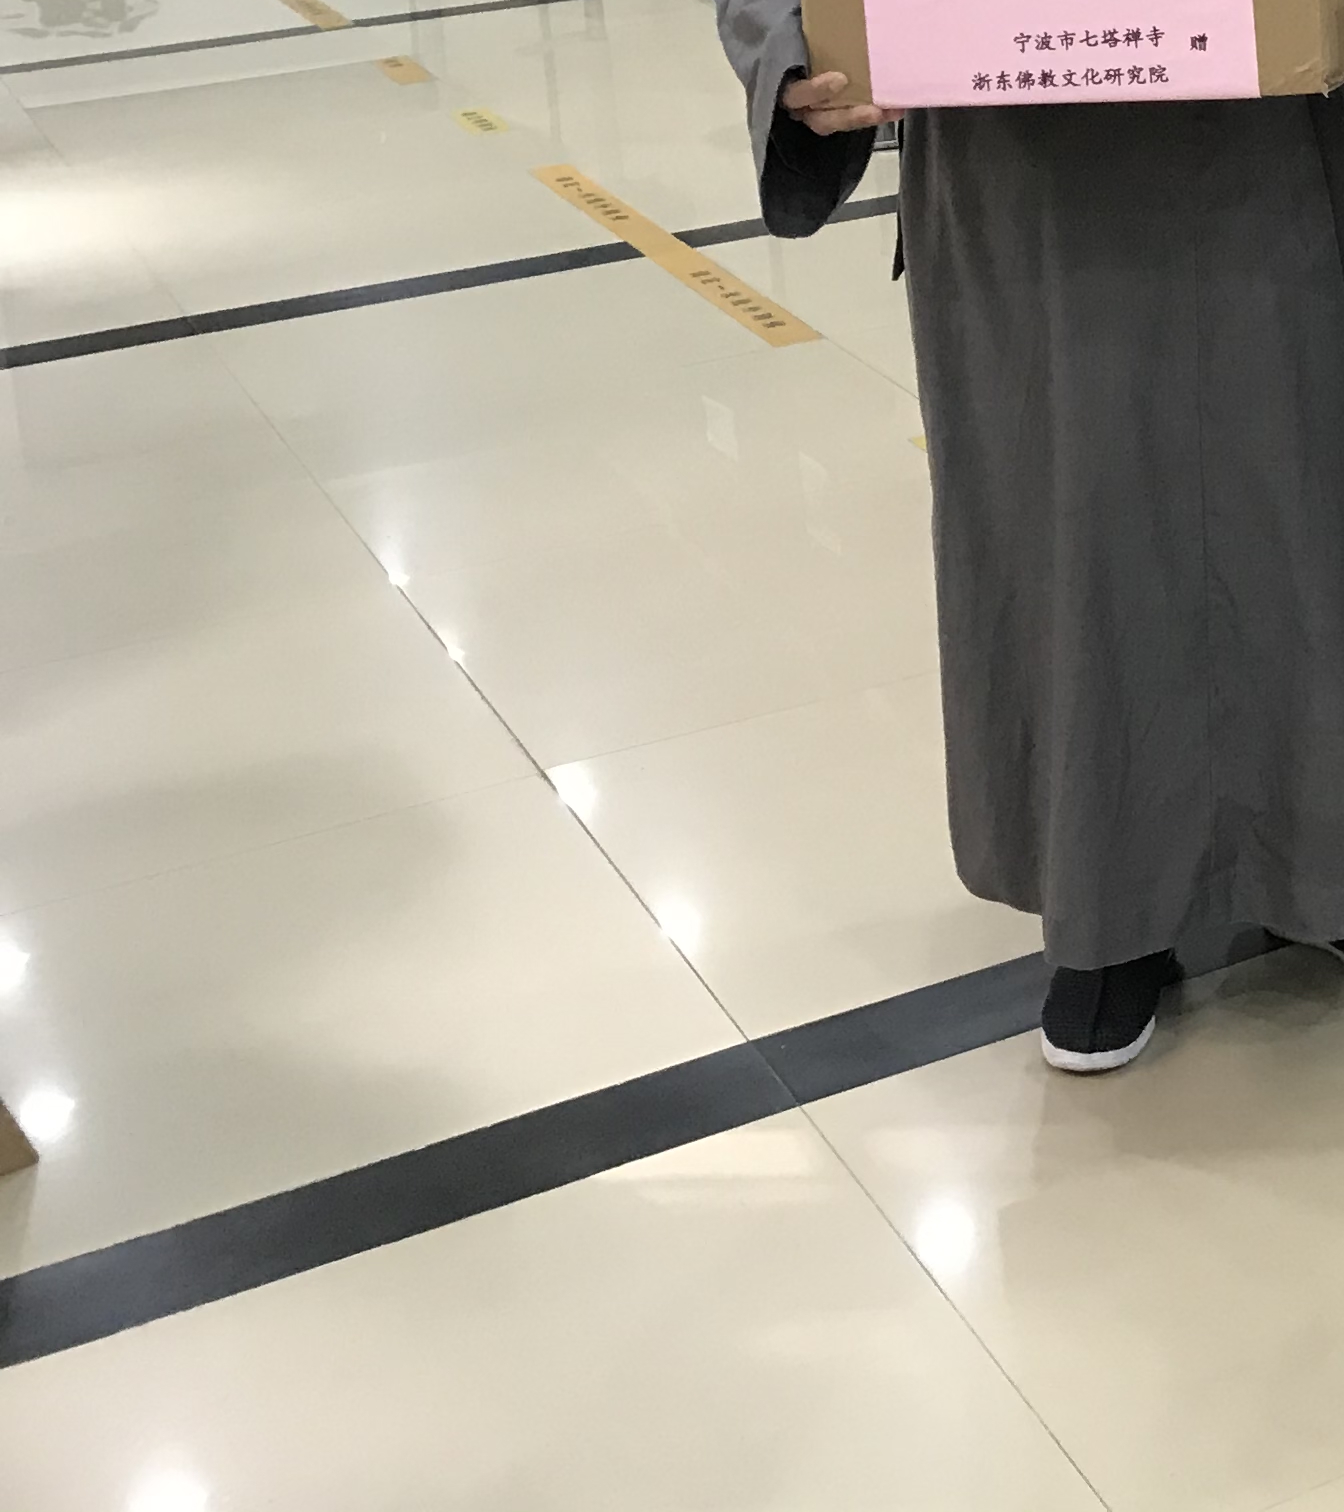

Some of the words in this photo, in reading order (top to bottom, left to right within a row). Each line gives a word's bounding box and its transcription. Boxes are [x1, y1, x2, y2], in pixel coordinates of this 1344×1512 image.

[1013, 26, 1165, 53] 宁波市七塔禅寺
[1190, 33, 1208, 52] 赠
[971, 64, 1169, 92] 浙东佛教文化研究院
